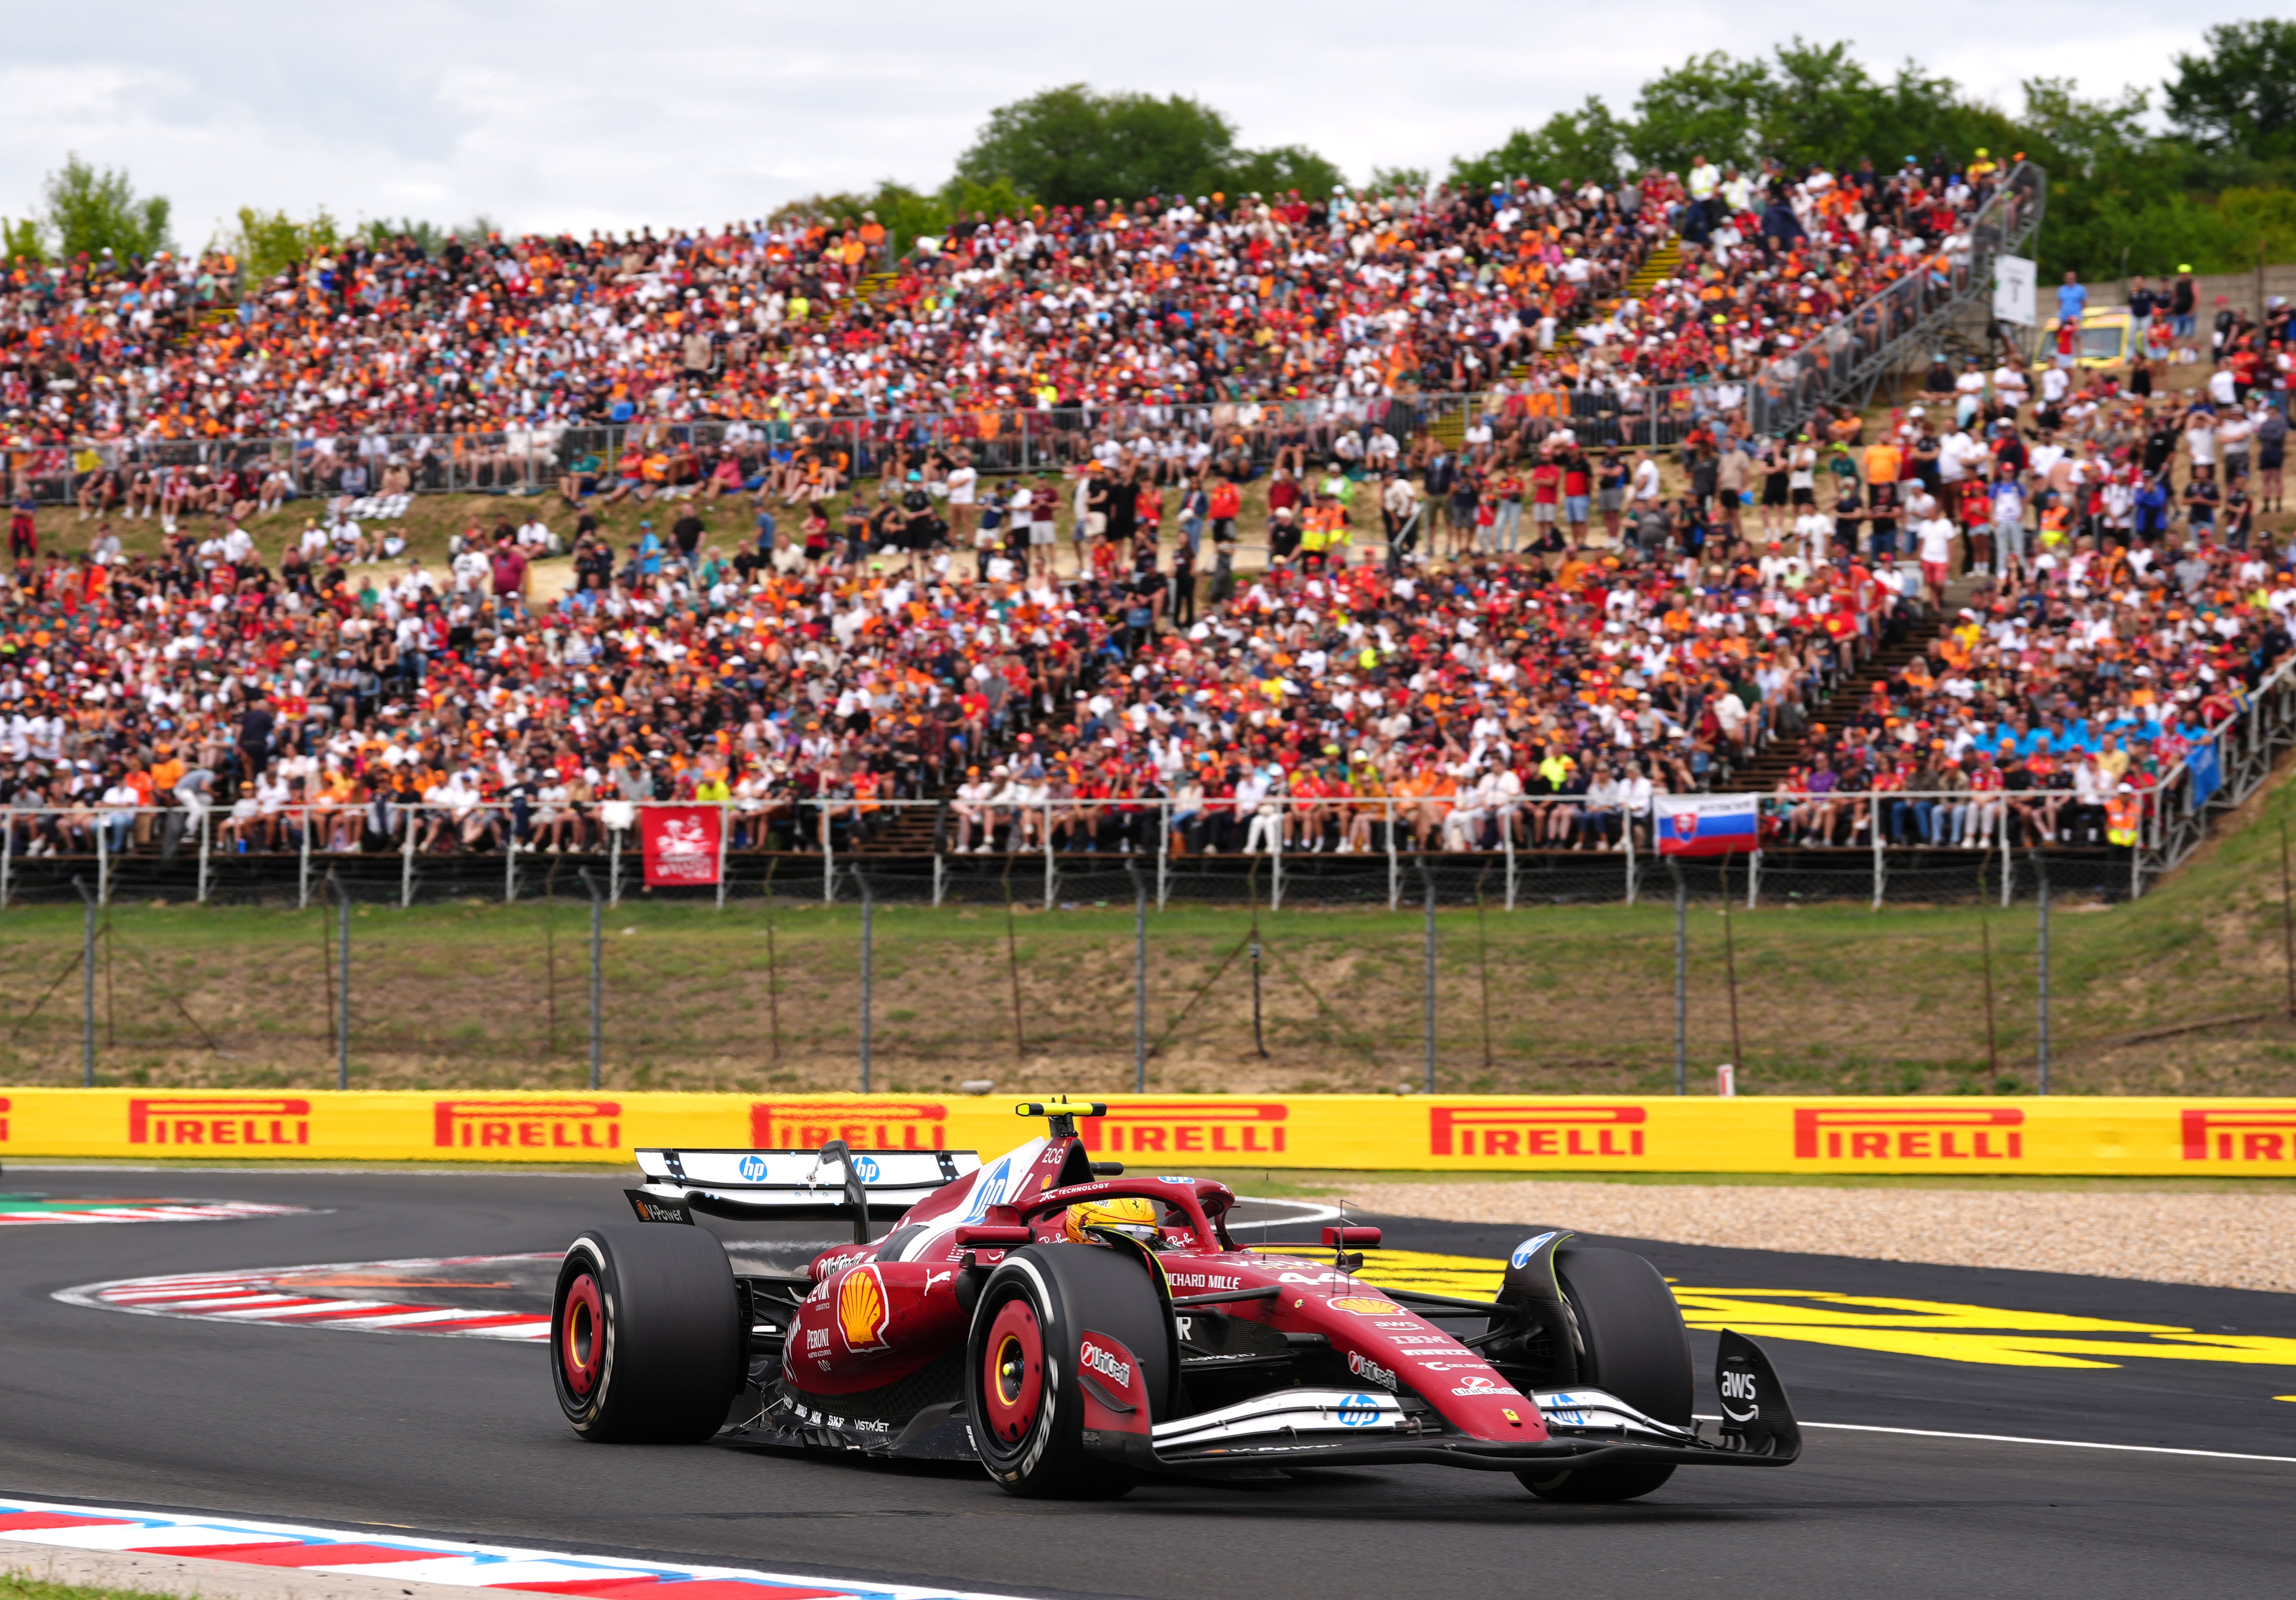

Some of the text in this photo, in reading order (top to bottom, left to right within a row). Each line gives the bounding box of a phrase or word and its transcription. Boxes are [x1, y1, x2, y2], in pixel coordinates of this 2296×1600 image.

[128, 1098, 311, 1144] PIRELLI
[434, 1100, 621, 1148] PIRELLI
[749, 1103, 947, 1151] PIRELLI
[1081, 1104, 1287, 1152] PIRELLI
[1430, 1106, 1646, 1155] PIRELLI
[1794, 1108, 2024, 1158] PIRELLI
[742, 1156, 765, 1182] hp
[853, 1156, 877, 1182] hp
[1058, 1182, 1110, 1195] TECHNOLOGY
[646, 1204, 683, 1222] V-Power
[1208, 1275, 1242, 1290] MILLE
[1277, 1272, 1361, 1286] 44
[815, 1302, 830, 1312] LOGISTICS
[807, 1327, 830, 1350] PERONI
[1387, 1335, 1451, 1344] IBM
[817, 1349, 832, 1357] AZZURRO
[1093, 1346, 1130, 1388] UniCredit
[1358, 1355, 1398, 1392] UniCredit
[1721, 1370, 1757, 1400] aws
[826, 1414, 845, 1428] SKF
[854, 1418, 889, 1432] VISTAJET
